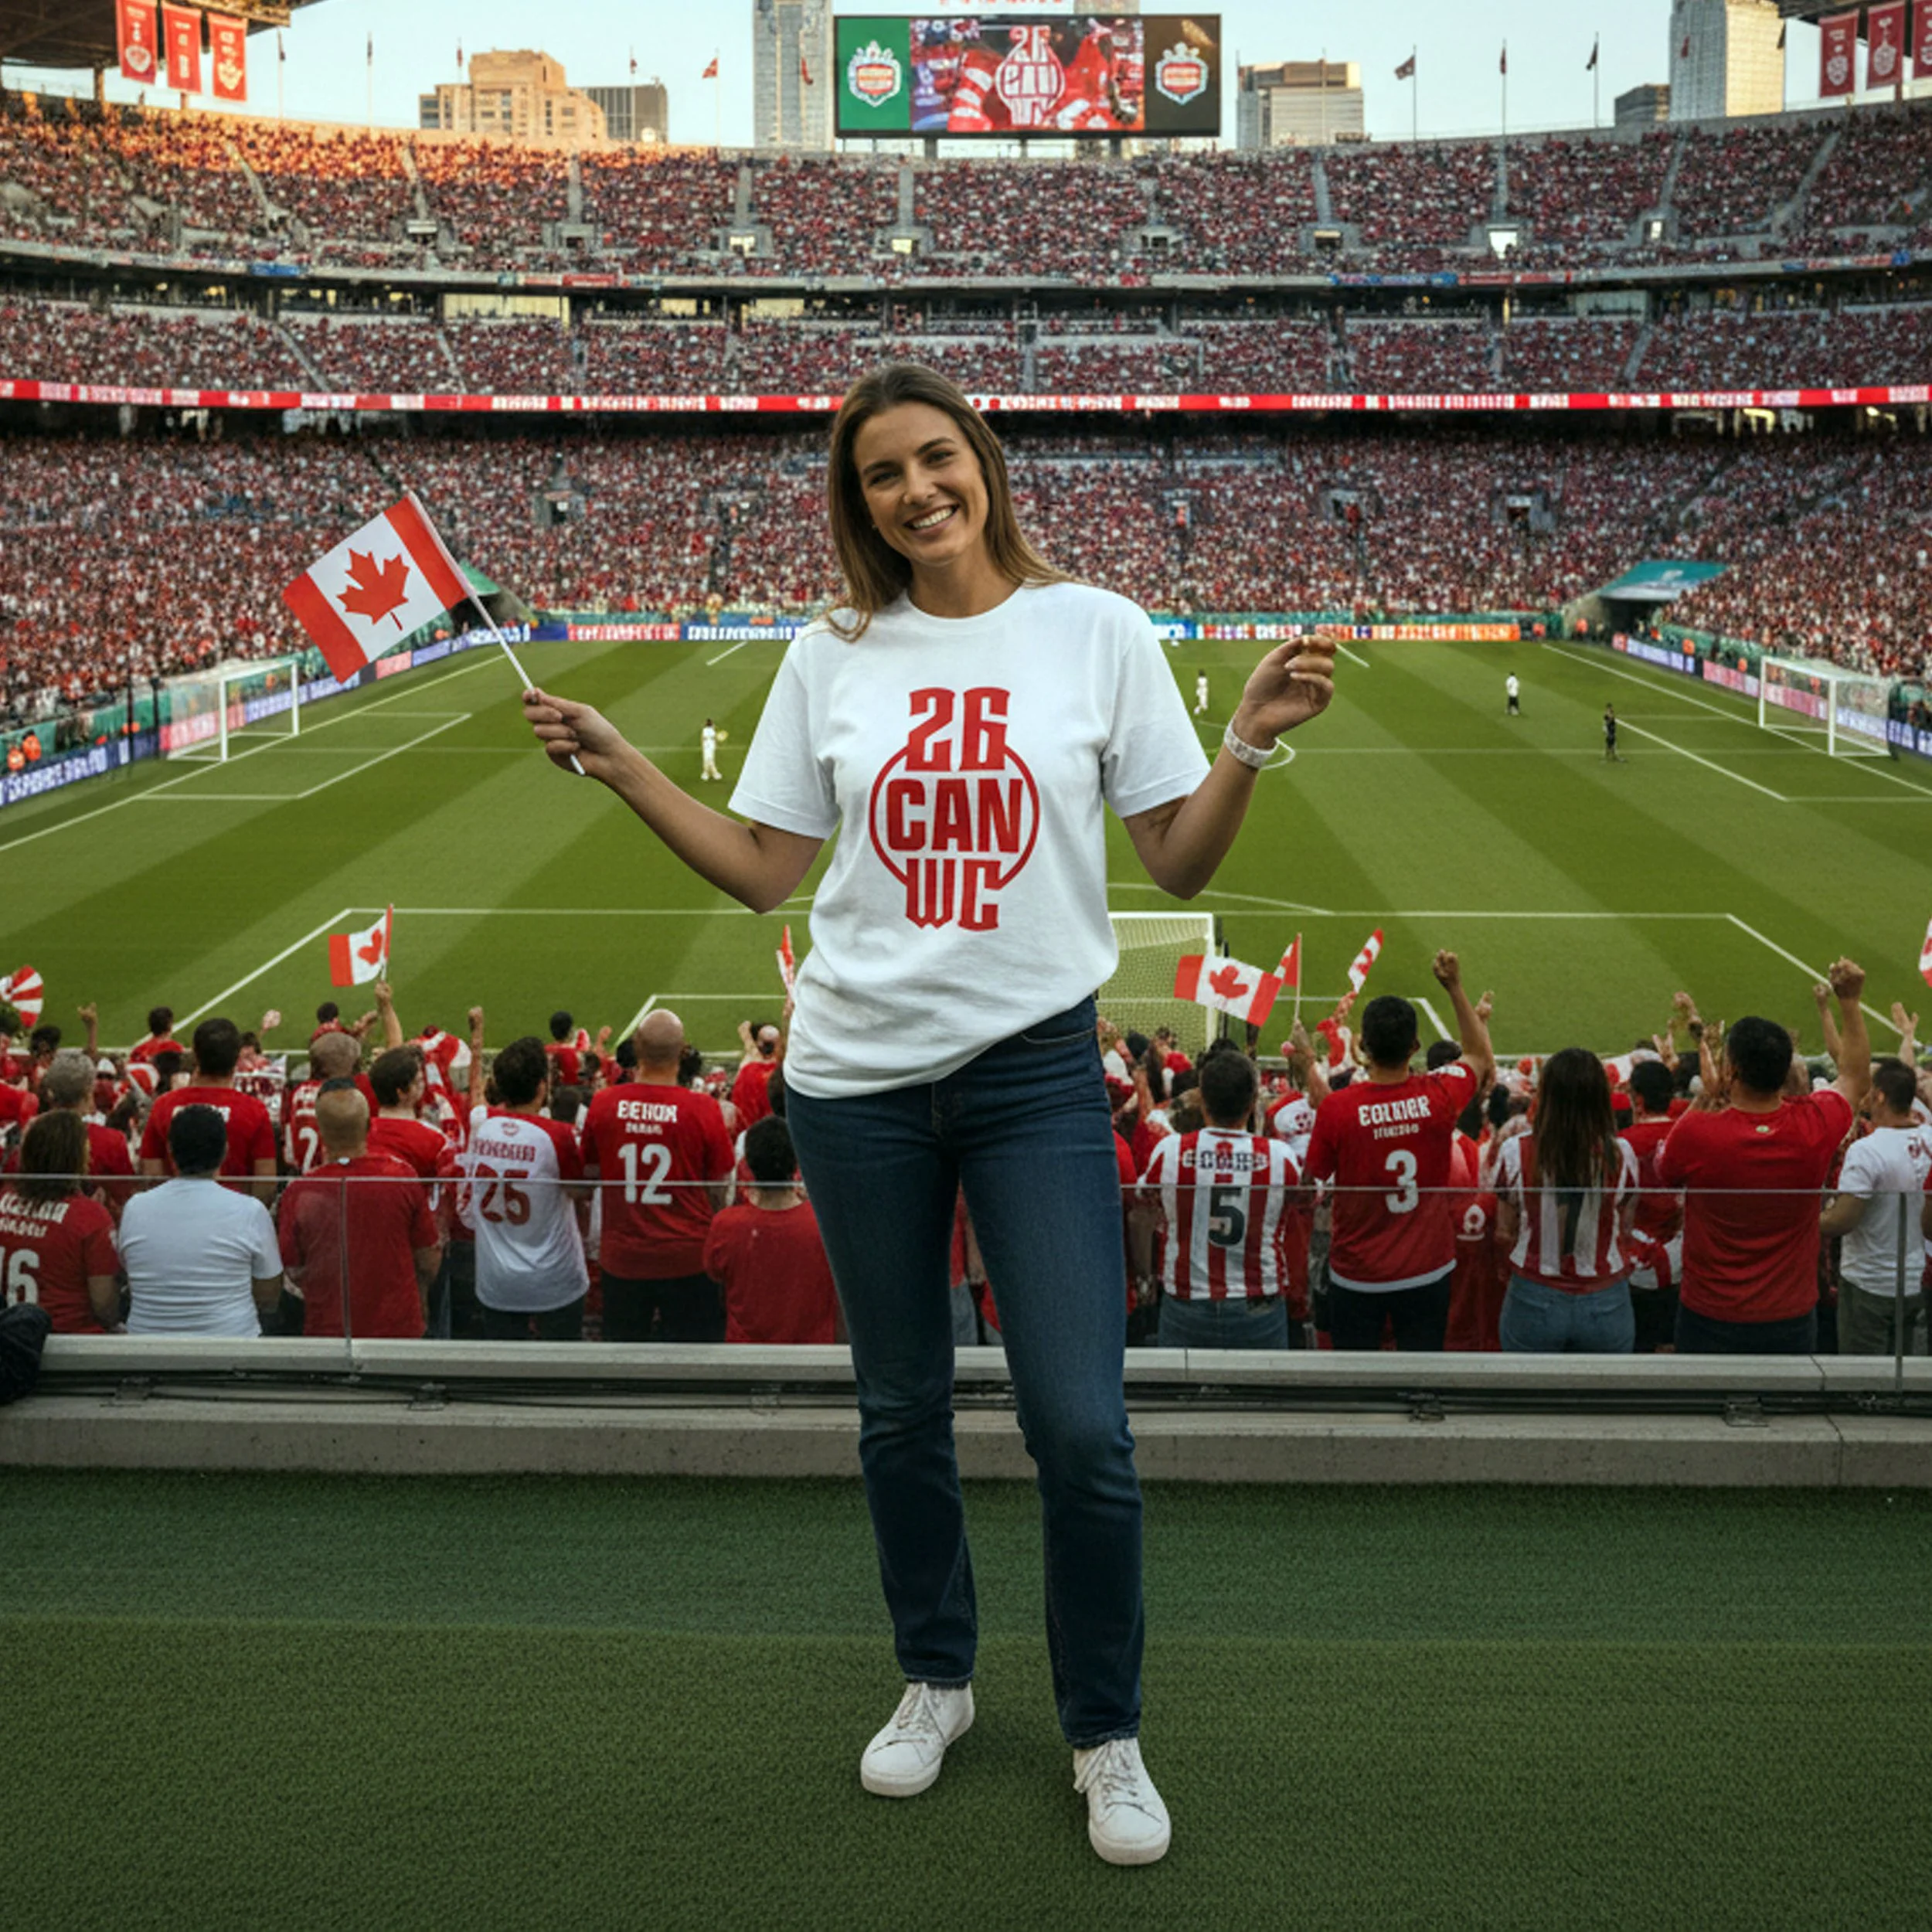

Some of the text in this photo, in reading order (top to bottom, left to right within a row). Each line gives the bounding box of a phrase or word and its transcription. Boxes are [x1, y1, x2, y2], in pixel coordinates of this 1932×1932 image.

[905, 687, 1010, 771] 26
[886, 778, 1023, 853] CAN
[906, 858, 1002, 932] WC
[474, 1162, 531, 1226] 25
[617, 1142, 672, 1204] 12
[1385, 1148, 1419, 1213] 3
[1208, 1186, 1245, 1246] 5
